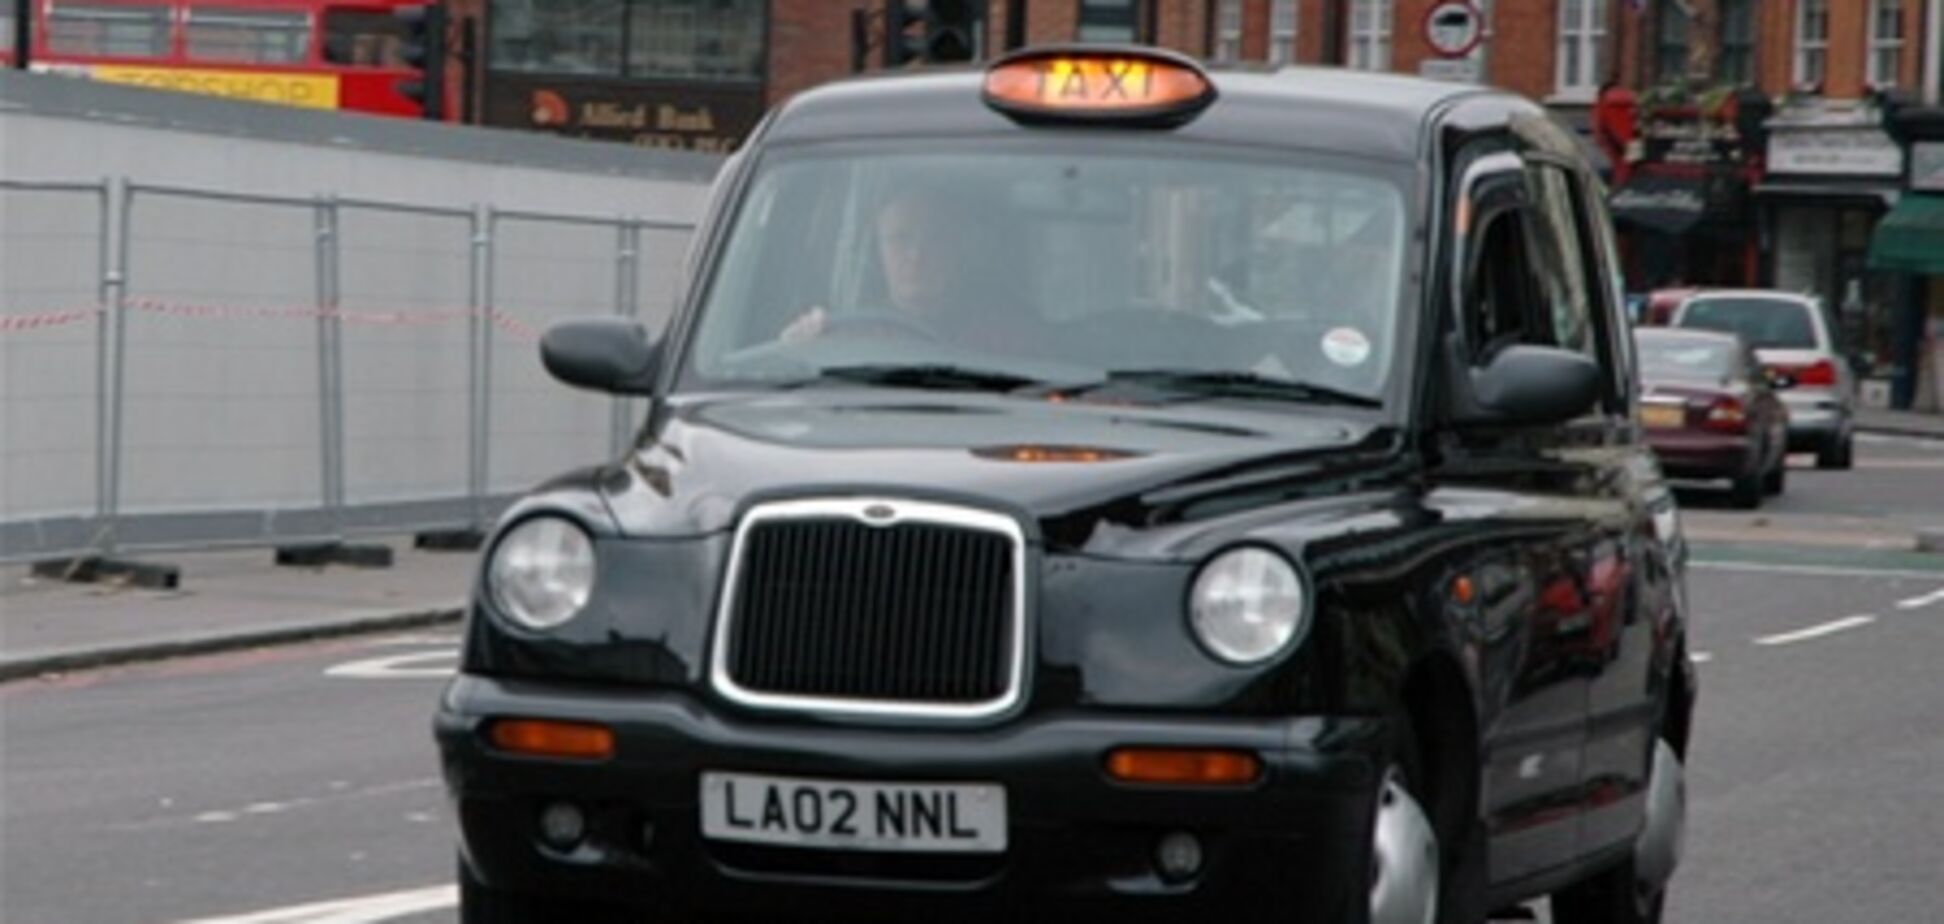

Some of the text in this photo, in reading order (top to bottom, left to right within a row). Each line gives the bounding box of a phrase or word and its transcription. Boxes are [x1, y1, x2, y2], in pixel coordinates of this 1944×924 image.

[1032, 63, 1154, 99] TAXI
[580, 102, 714, 130] Allied Bank
[724, 780, 979, 839] LA02 NNL
